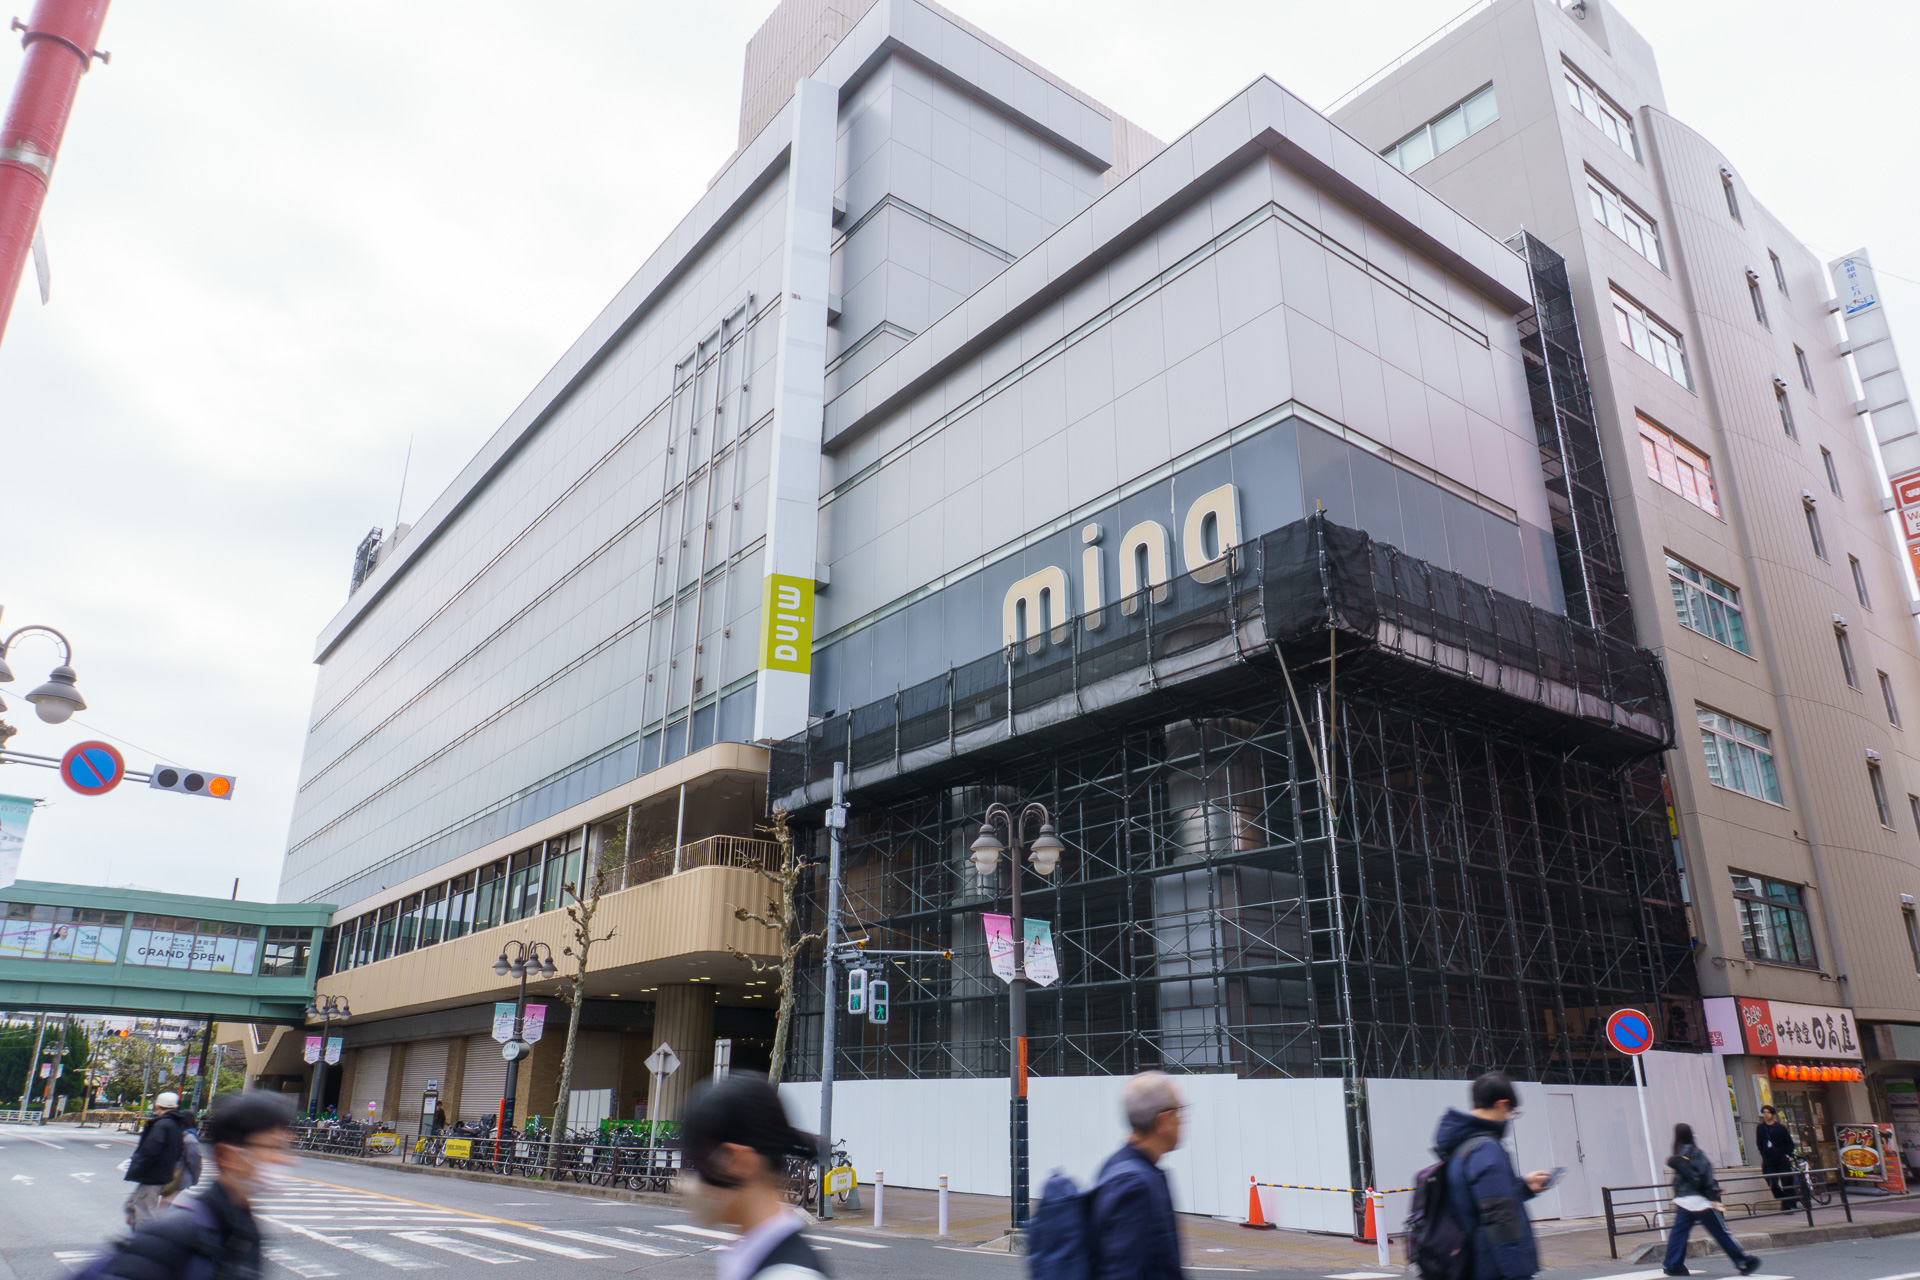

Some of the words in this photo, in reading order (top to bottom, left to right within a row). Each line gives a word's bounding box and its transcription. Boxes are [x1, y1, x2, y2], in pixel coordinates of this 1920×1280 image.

[1002, 483, 1245, 662] mina
[775, 585, 806, 662] mina
[138, 947, 184, 959] GRAND
[188, 952, 225, 962] OPEN
[1743, 1005, 1762, 1026] ちょい
[1757, 1024, 1773, 1047] 飲み
[1776, 1016, 1811, 1045] 中華食堂
[1812, 1013, 1855, 1053] 日高屋
[1838, 1127, 1873, 1148] チゲ
